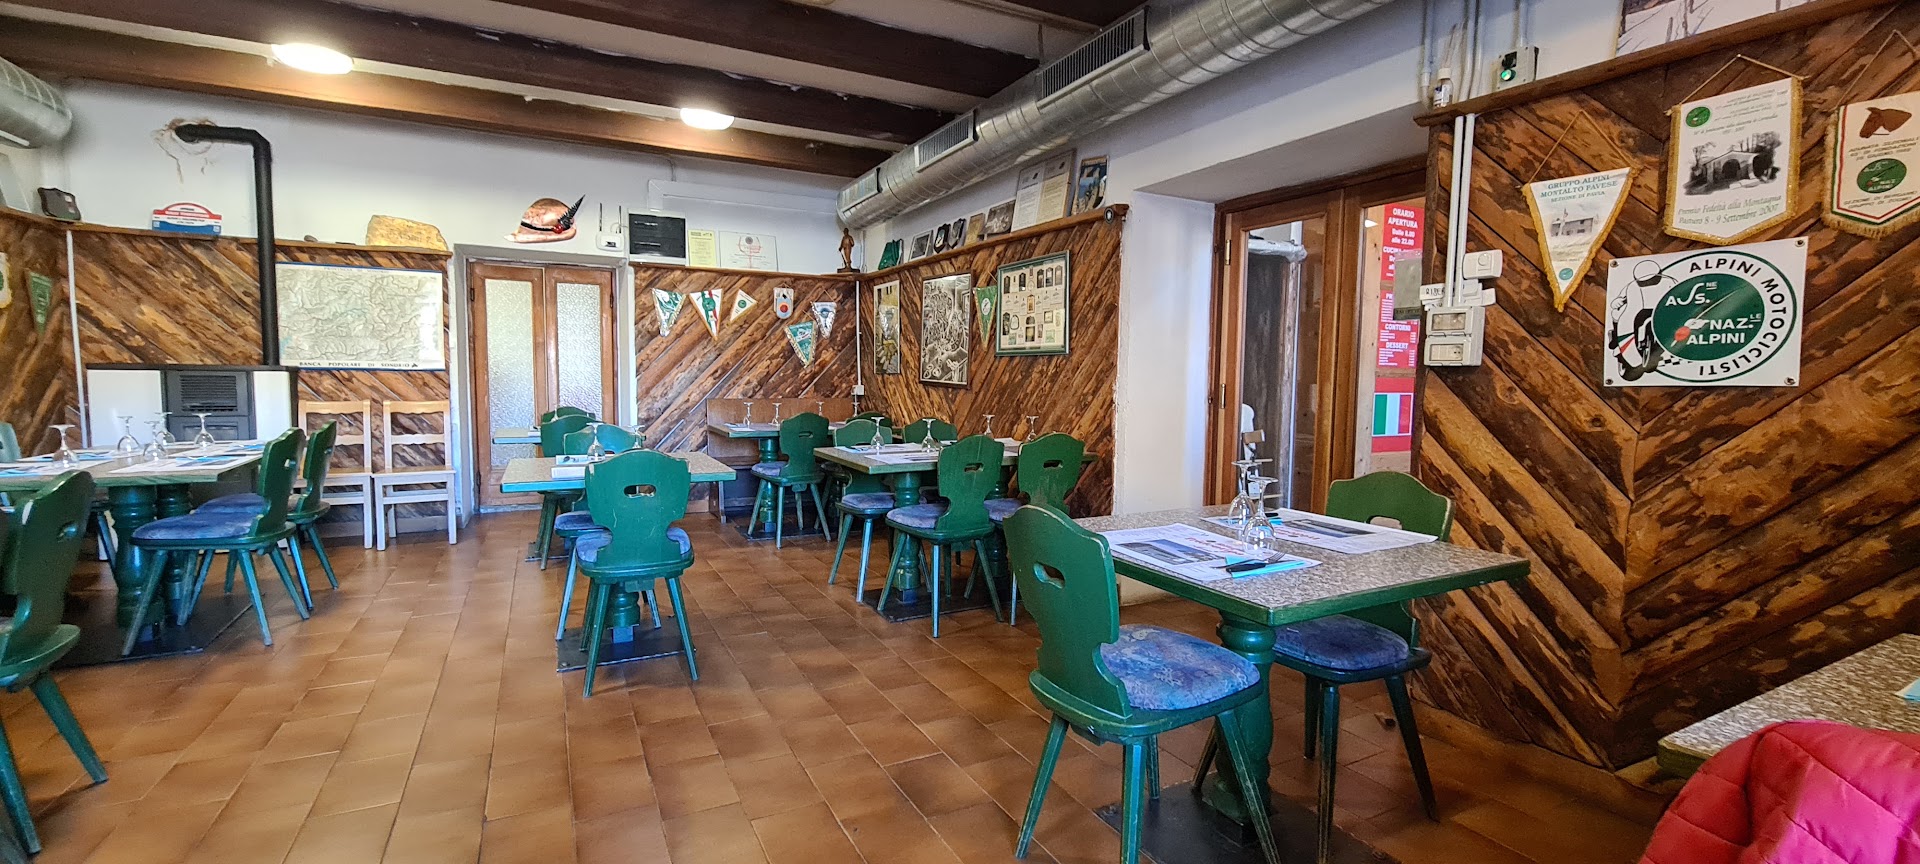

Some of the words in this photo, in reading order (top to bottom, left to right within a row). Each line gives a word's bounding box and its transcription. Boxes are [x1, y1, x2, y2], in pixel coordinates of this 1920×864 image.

[1541, 185, 1584, 198] MONTALTO
[1586, 180, 1618, 191] PAVESE
[1548, 179, 1580, 190] GRUPPO
[1582, 175, 1610, 185] ALPINI
[1551, 194, 1576, 203] SEZIONE
[1727, 198, 1741, 209] alla
[1743, 194, 1782, 207] Montagna
[1392, 208, 1415, 219] ORARIO
[1716, 214, 1722, 224] 9
[1723, 209, 1757, 223] Settembre
[1759, 203, 1780, 216] 2007
[1387, 217, 1418, 229] APERTURA
[1391, 228, 1405, 237] Dalle
[1689, 258, 1762, 278] ALPINI
[1384, 324, 1412, 332] CONTORNI
[1698, 278, 1788, 377] MOTOCICLISTI
[1709, 317, 1754, 330] NAZ.
[1686, 332, 1746, 346] ALPINI
[1385, 342, 1409, 350] DESSERT
